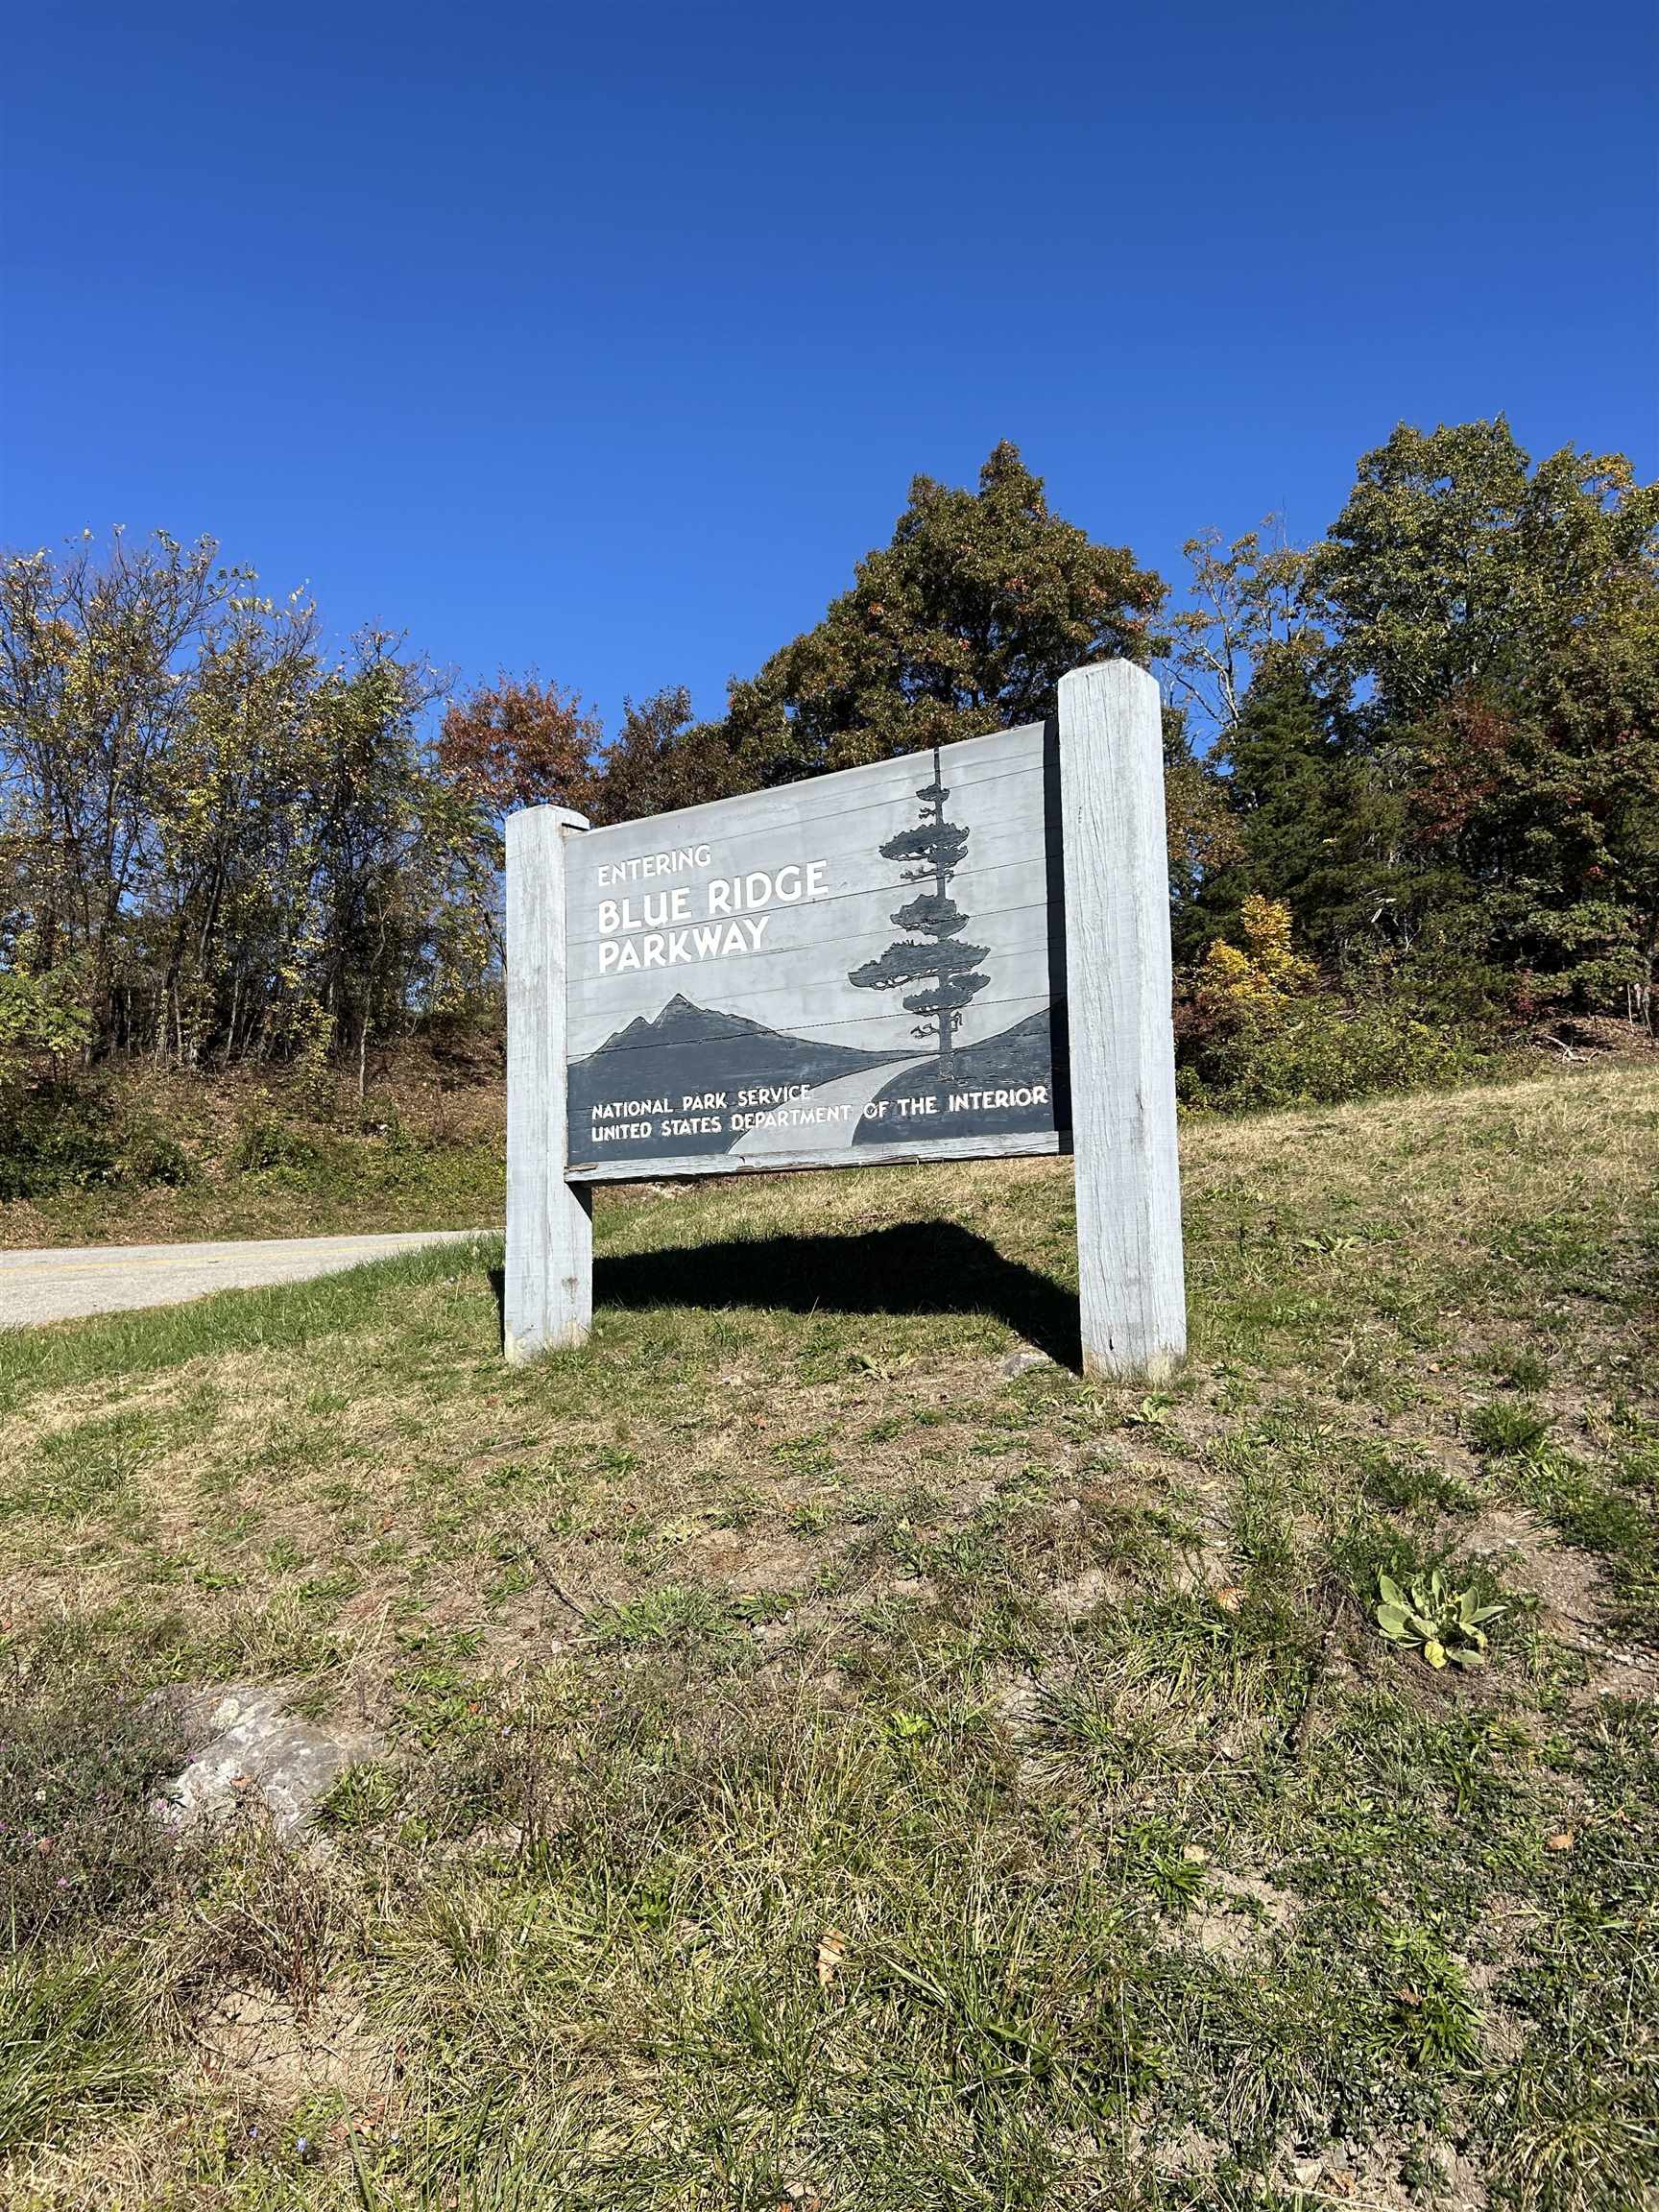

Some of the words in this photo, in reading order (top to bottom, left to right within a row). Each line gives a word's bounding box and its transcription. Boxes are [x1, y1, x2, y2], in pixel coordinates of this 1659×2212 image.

[598, 844, 711, 887] ENTERING
[598, 886, 692, 934] BLUE
[708, 859, 830, 915] RIDGE
[598, 915, 770, 974] PARKWAY
[591, 1098, 674, 1120] NATIONAL
[683, 1093, 728, 1111] PARK
[737, 1084, 813, 1107] SERVICE
[591, 1122, 652, 1142] UNITED
[661, 1117, 722, 1137] STATES
[732, 1104, 852, 1131] DEPARTMENT
[863, 1100, 890, 1119] OF
[898, 1095, 938, 1117] THE
[948, 1085, 1048, 1112] INTERIOR
